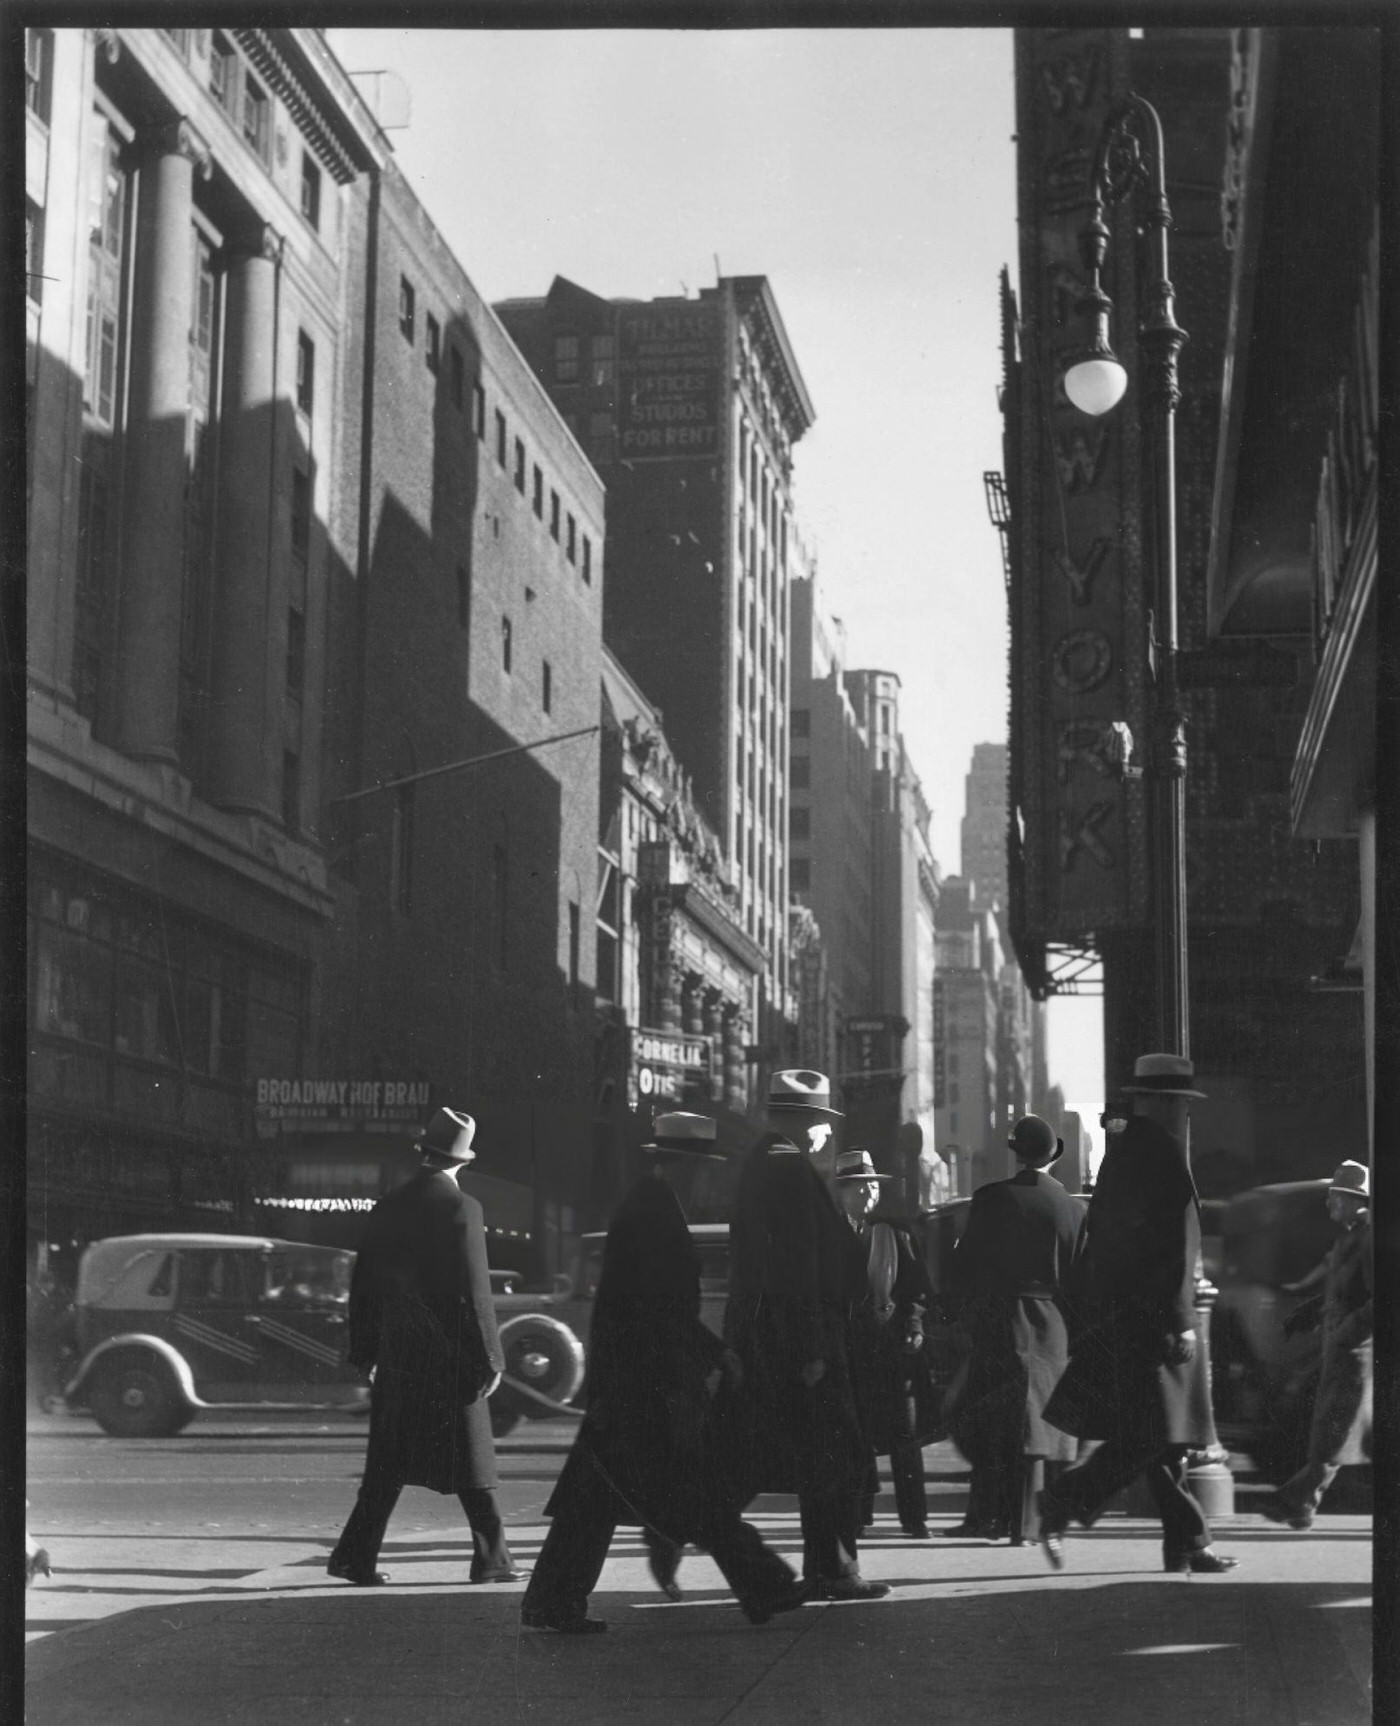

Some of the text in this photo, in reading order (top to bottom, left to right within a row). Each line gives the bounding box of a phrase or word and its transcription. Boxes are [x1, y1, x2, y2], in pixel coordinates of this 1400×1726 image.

[630, 402, 707, 423] STUDIOS
[622, 425, 717, 448] FOR RENT
[1046, 536, 1122, 874] YORK
[633, 1036, 702, 1067] CORNELIA
[256, 1078, 430, 1106] BROADWAY HOF BRAU
